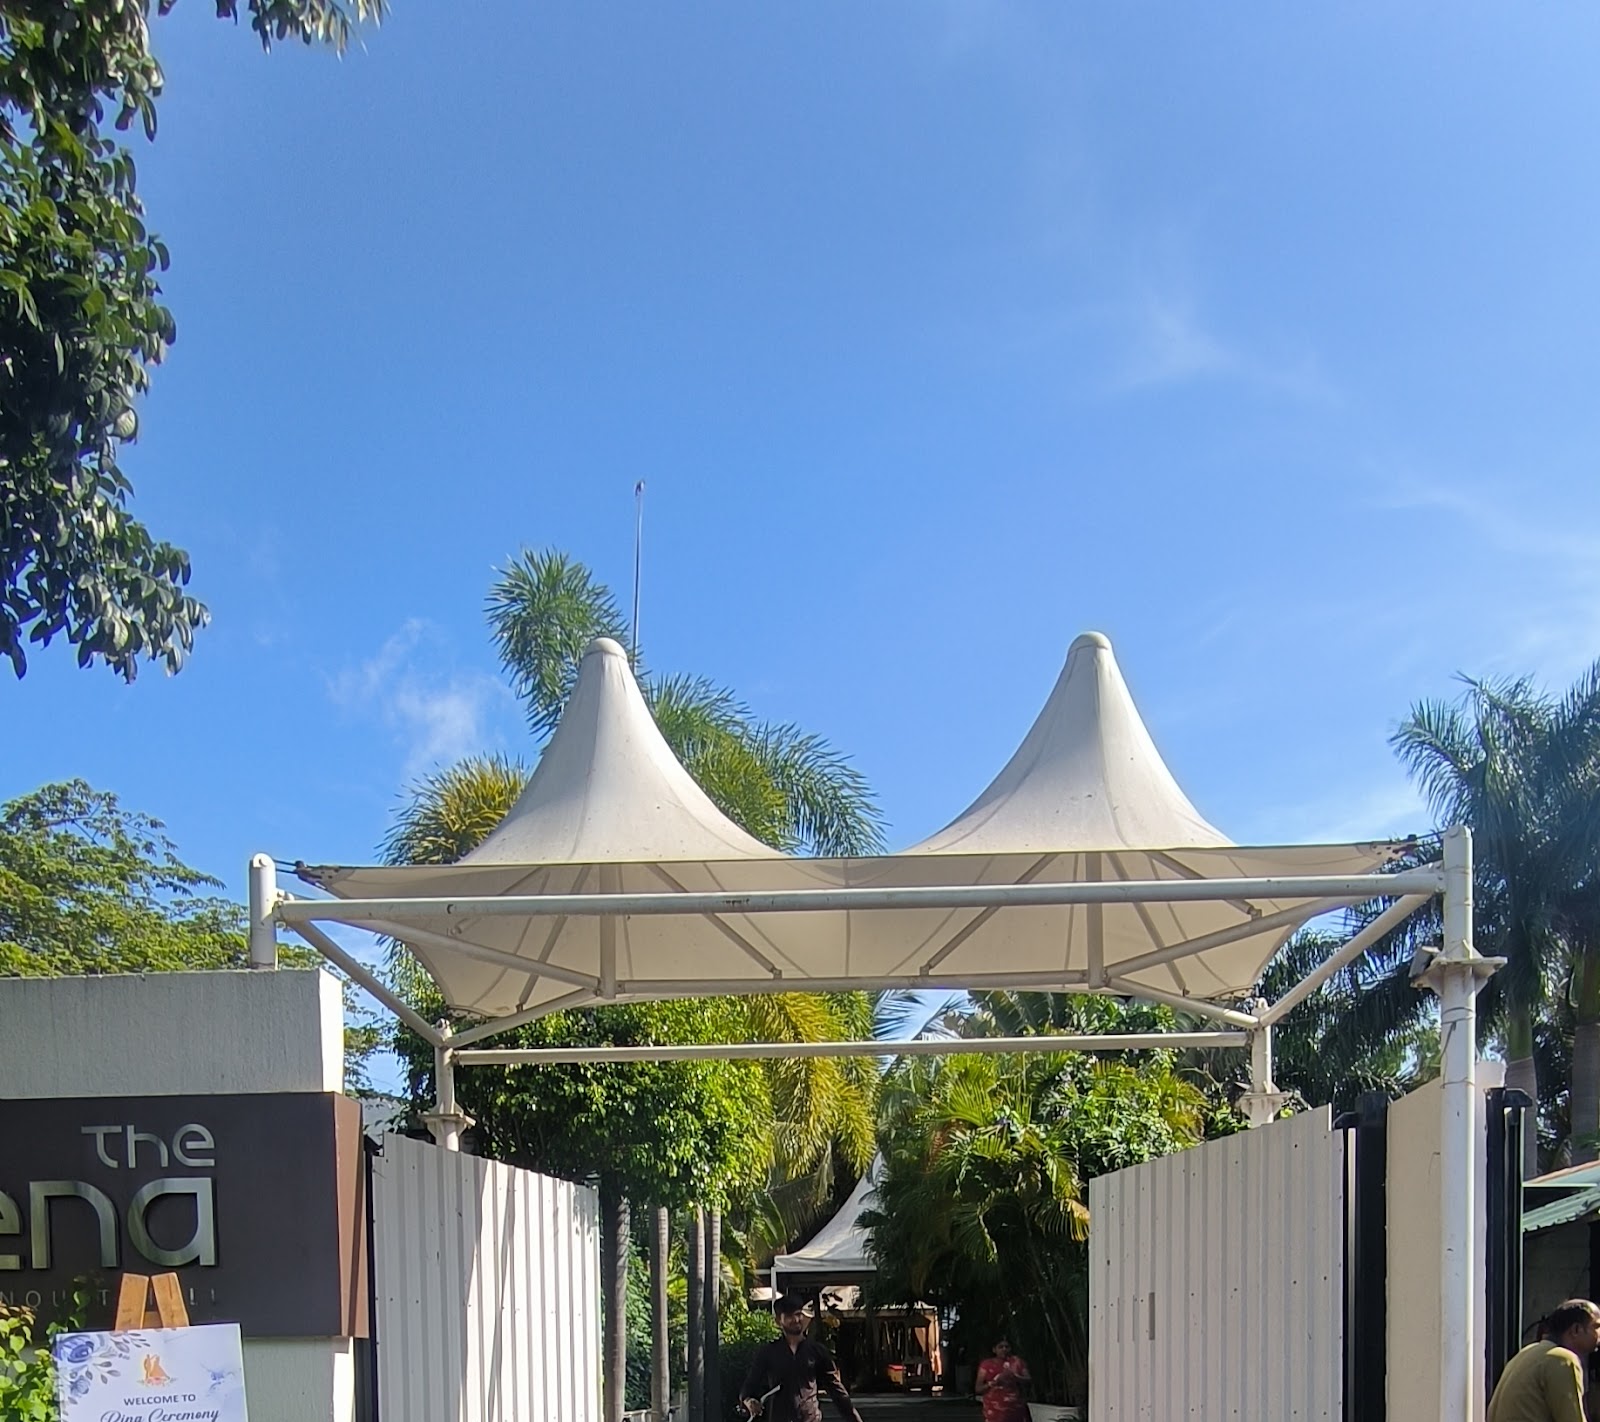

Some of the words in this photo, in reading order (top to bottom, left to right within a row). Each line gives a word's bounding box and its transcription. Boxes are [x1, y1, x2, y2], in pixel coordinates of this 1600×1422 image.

[0, 1177, 217, 1271] na
[123, 1394, 179, 1406] WELCOME
[181, 1393, 197, 1403] TO
